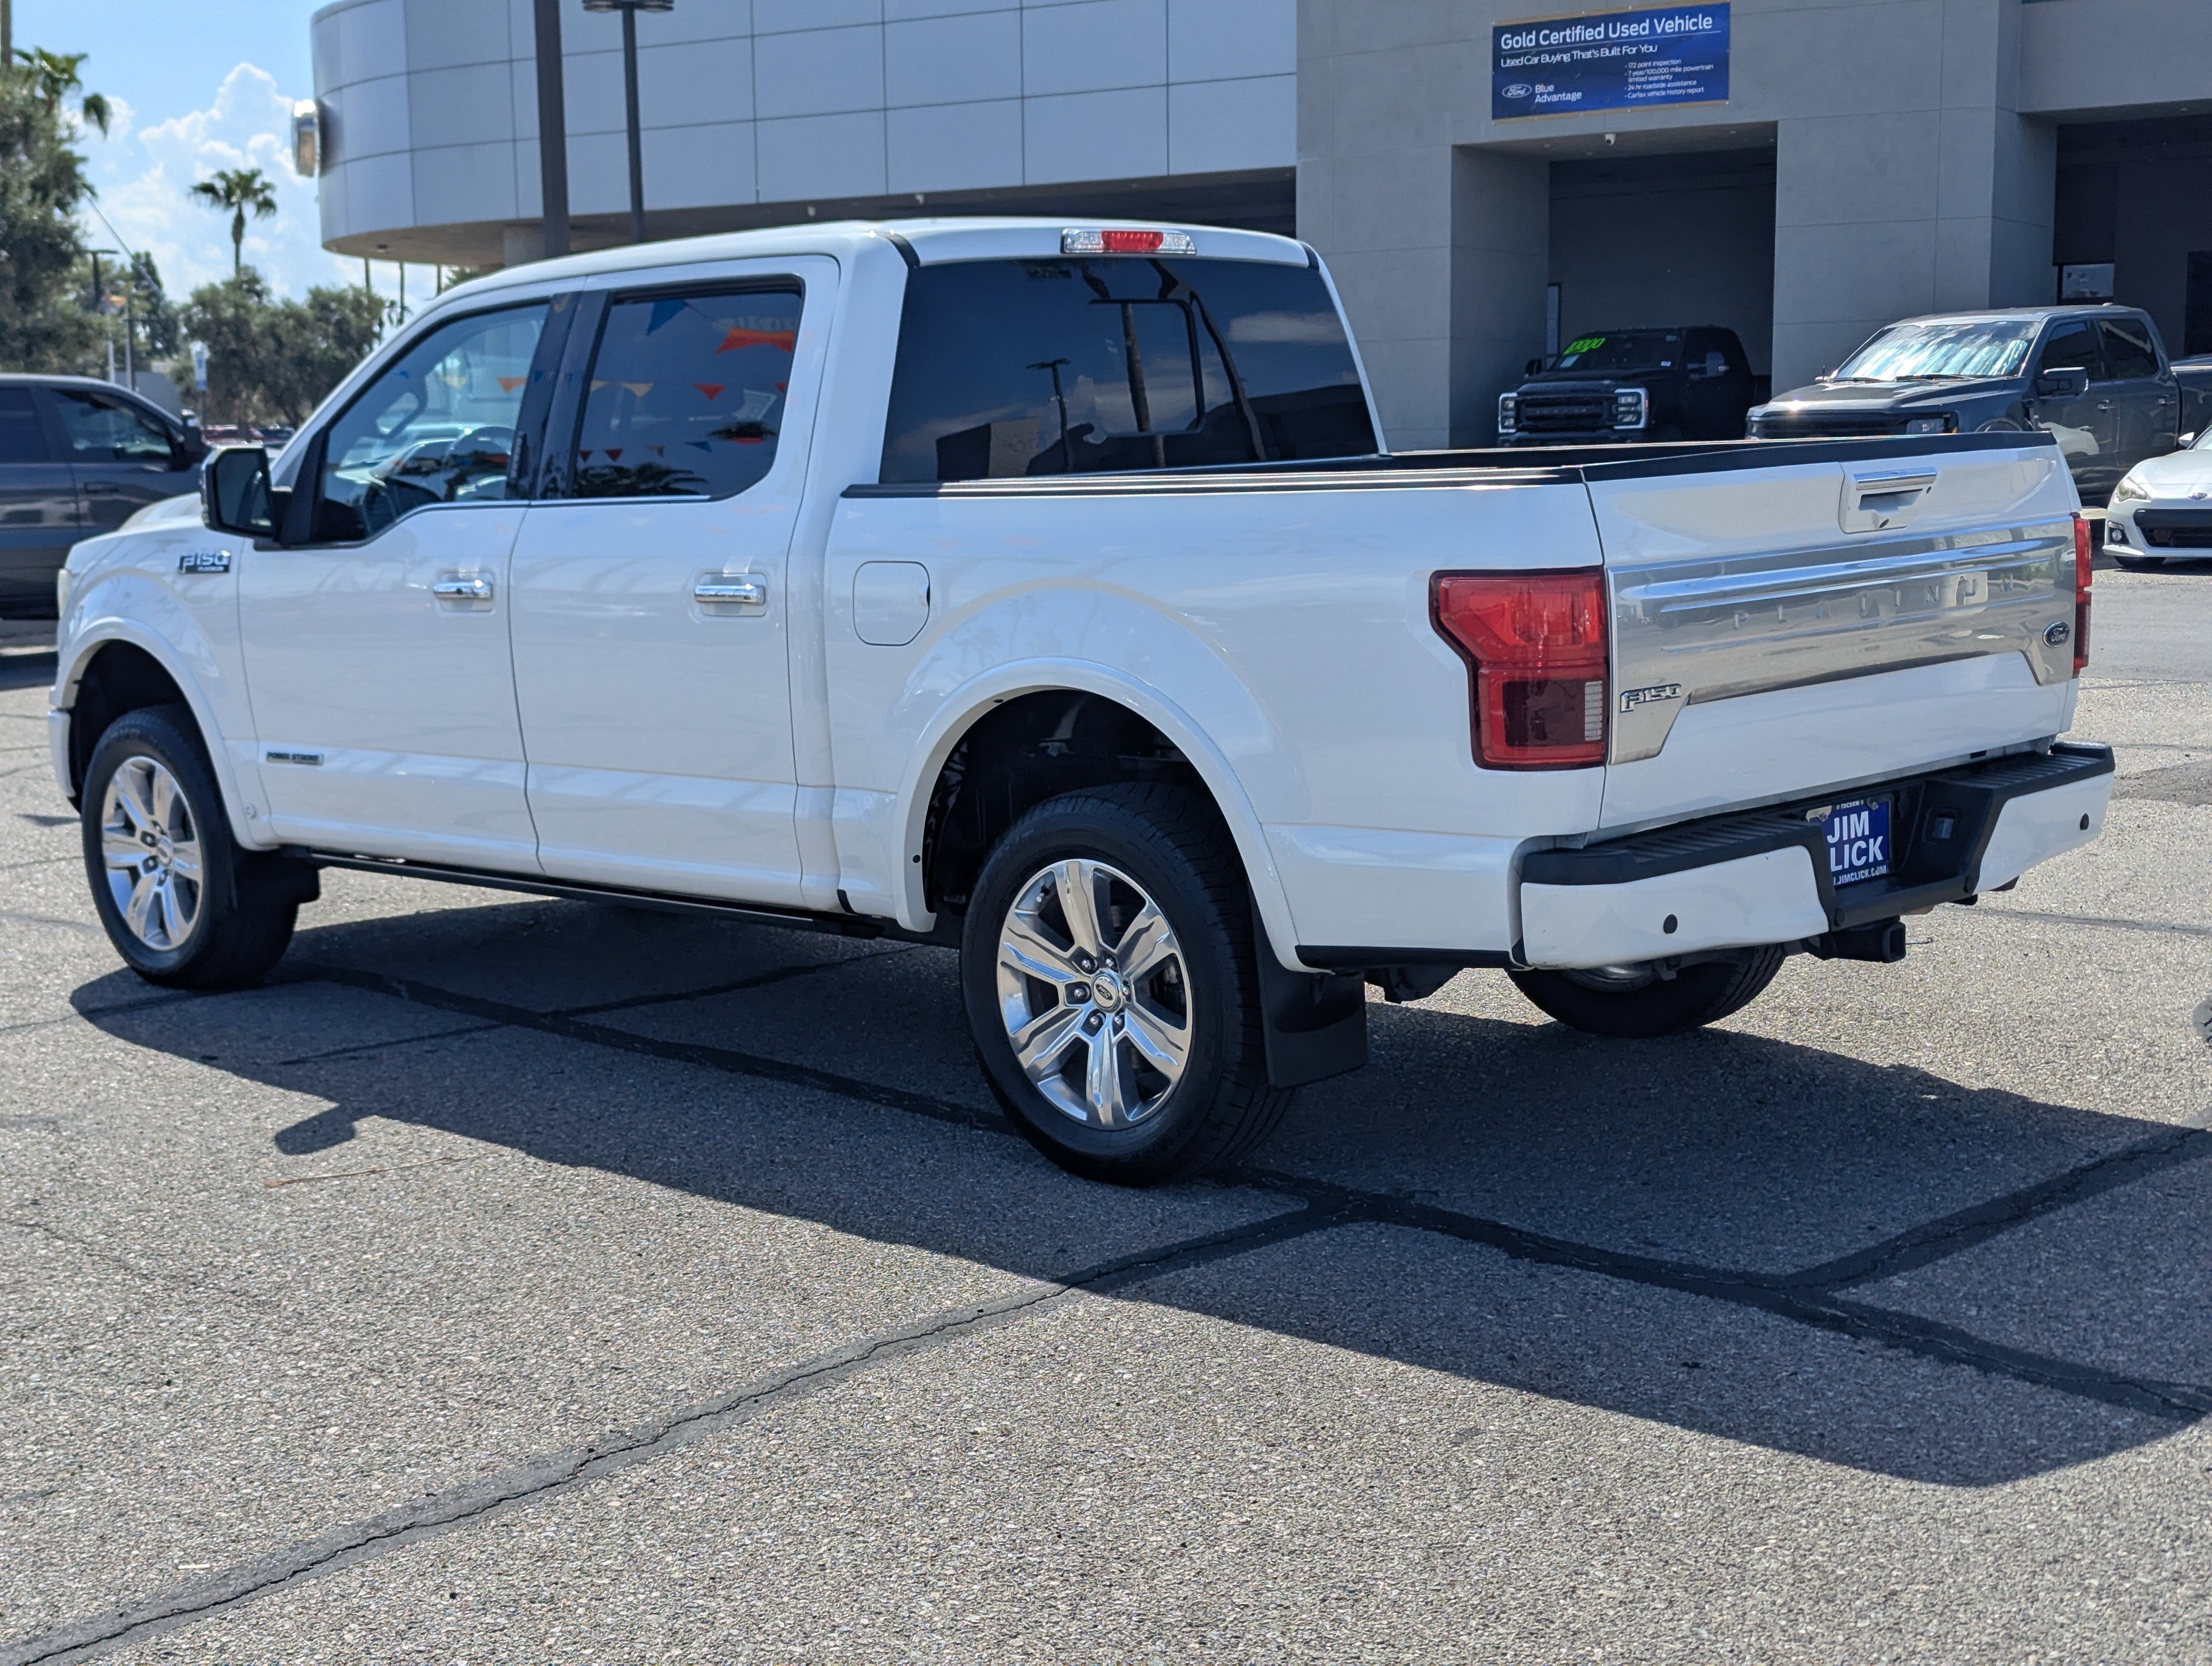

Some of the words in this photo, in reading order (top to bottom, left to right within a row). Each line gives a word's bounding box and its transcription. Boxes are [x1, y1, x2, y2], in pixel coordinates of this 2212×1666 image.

[1501, 30, 1536, 49] Gold
[1539, 23, 1605, 45] Certified
[1609, 18, 1649, 38] Used
[1654, 14, 1713, 34] Vehicle
[1501, 55, 1523, 67] Used
[1524, 55, 1540, 65] Car
[1541, 53, 1571, 64] Buying
[1572, 49, 1599, 60] That's
[1600, 46, 1621, 57] Built
[1622, 45, 1638, 55] For
[1639, 44, 1657, 53] You
[1683, 64, 1714, 73] powertrain
[1534, 91, 1583, 104] Advantage
[1535, 84, 1554, 94] Blue
[1733, 574, 2014, 630] PLATINUM
[1841, 800, 1860, 809] TUCSON
[1827, 810, 1870, 844] JIM
[1830, 836, 1884, 872] LICK
